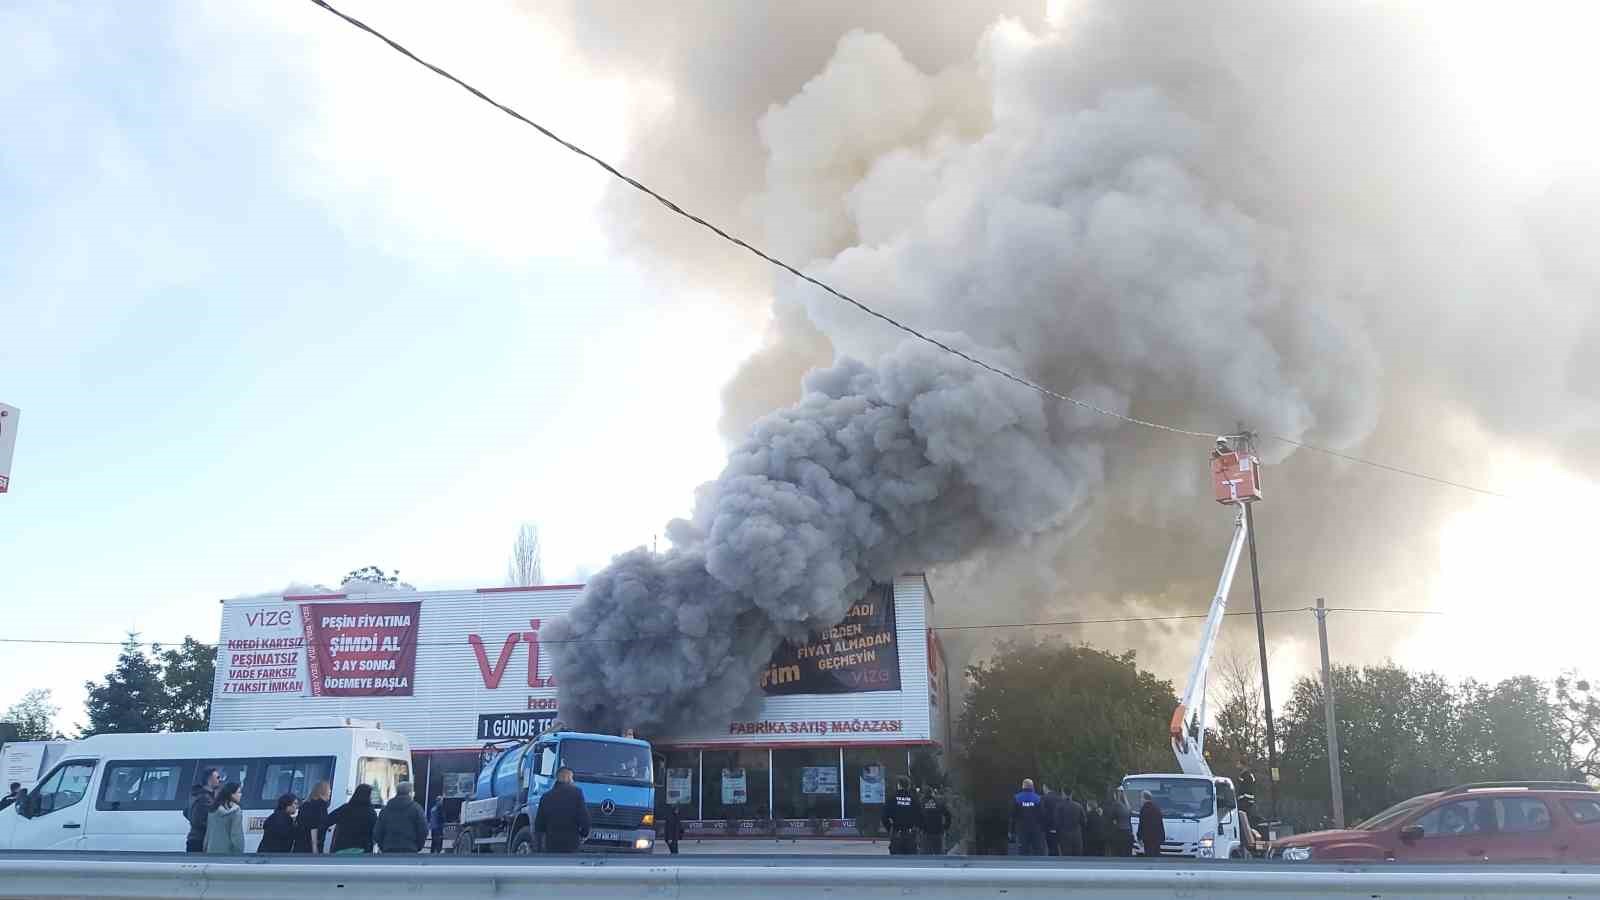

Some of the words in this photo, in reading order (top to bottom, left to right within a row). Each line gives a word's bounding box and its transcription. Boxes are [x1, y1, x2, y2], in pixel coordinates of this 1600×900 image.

[246, 609, 292, 627] vize
[321, 614, 355, 631] PEŞİN
[357, 613, 411, 628] FİYATINA
[228, 637, 259, 650] KREDİ
[261, 637, 305, 649] KARTSIZ
[329, 633, 378, 657] ŞİMDİ
[380, 636, 401, 652] AL
[834, 631, 891, 653] ALMADAN
[231, 652, 299, 668] PEŞİNATSIZ
[333, 660, 341, 671] 3
[342, 660, 358, 671] AY
[359, 660, 396, 671] SONRA
[818, 649, 876, 671] GEÇMEYİN
[228, 669, 256, 679] VADE
[257, 667, 298, 678] FARKSIZ
[223, 683, 230, 692] 7
[231, 682, 267, 692] TAKSİT
[268, 681, 304, 692] İMKAN
[324, 676, 373, 689] ÖDEMEYE
[374, 677, 408, 691] BAŞLA
[483, 719, 489, 737] 1
[493, 714, 536, 737] GÜNDE
[729, 719, 787, 735] FABRİKA
[790, 720, 828, 736] SATIŞ
[831, 718, 903, 733] MAĞAZASI
